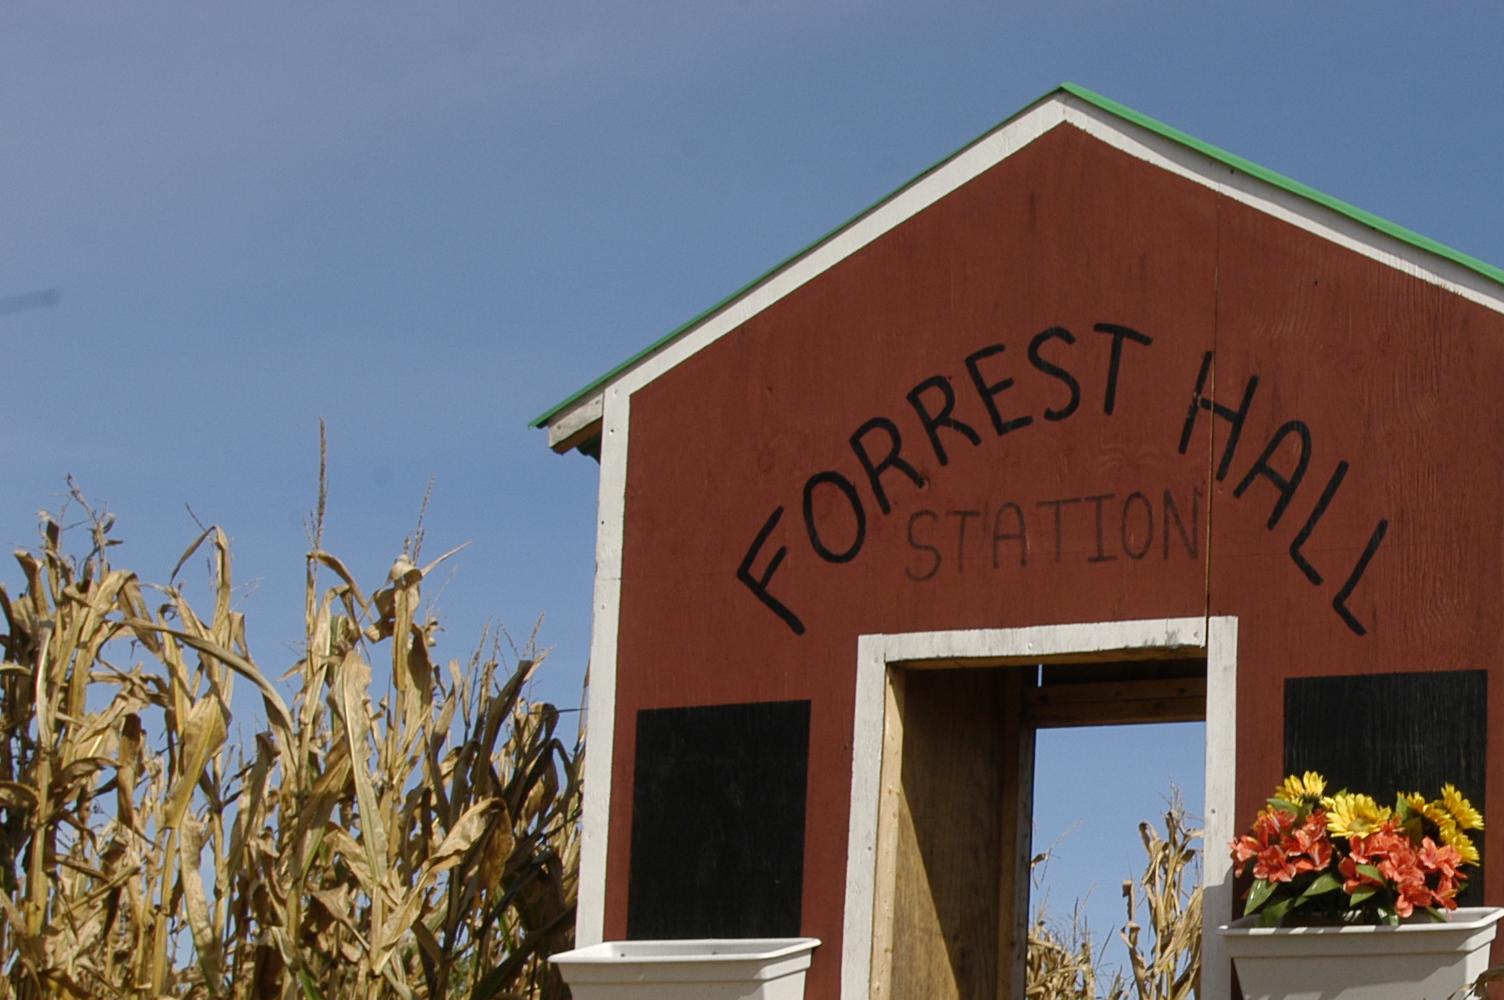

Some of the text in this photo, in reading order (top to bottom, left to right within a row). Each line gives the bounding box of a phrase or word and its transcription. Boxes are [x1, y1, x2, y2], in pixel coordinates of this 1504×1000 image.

[736, 322, 1389, 637] FORREST HALL
[904, 488, 1204, 582] STATION
